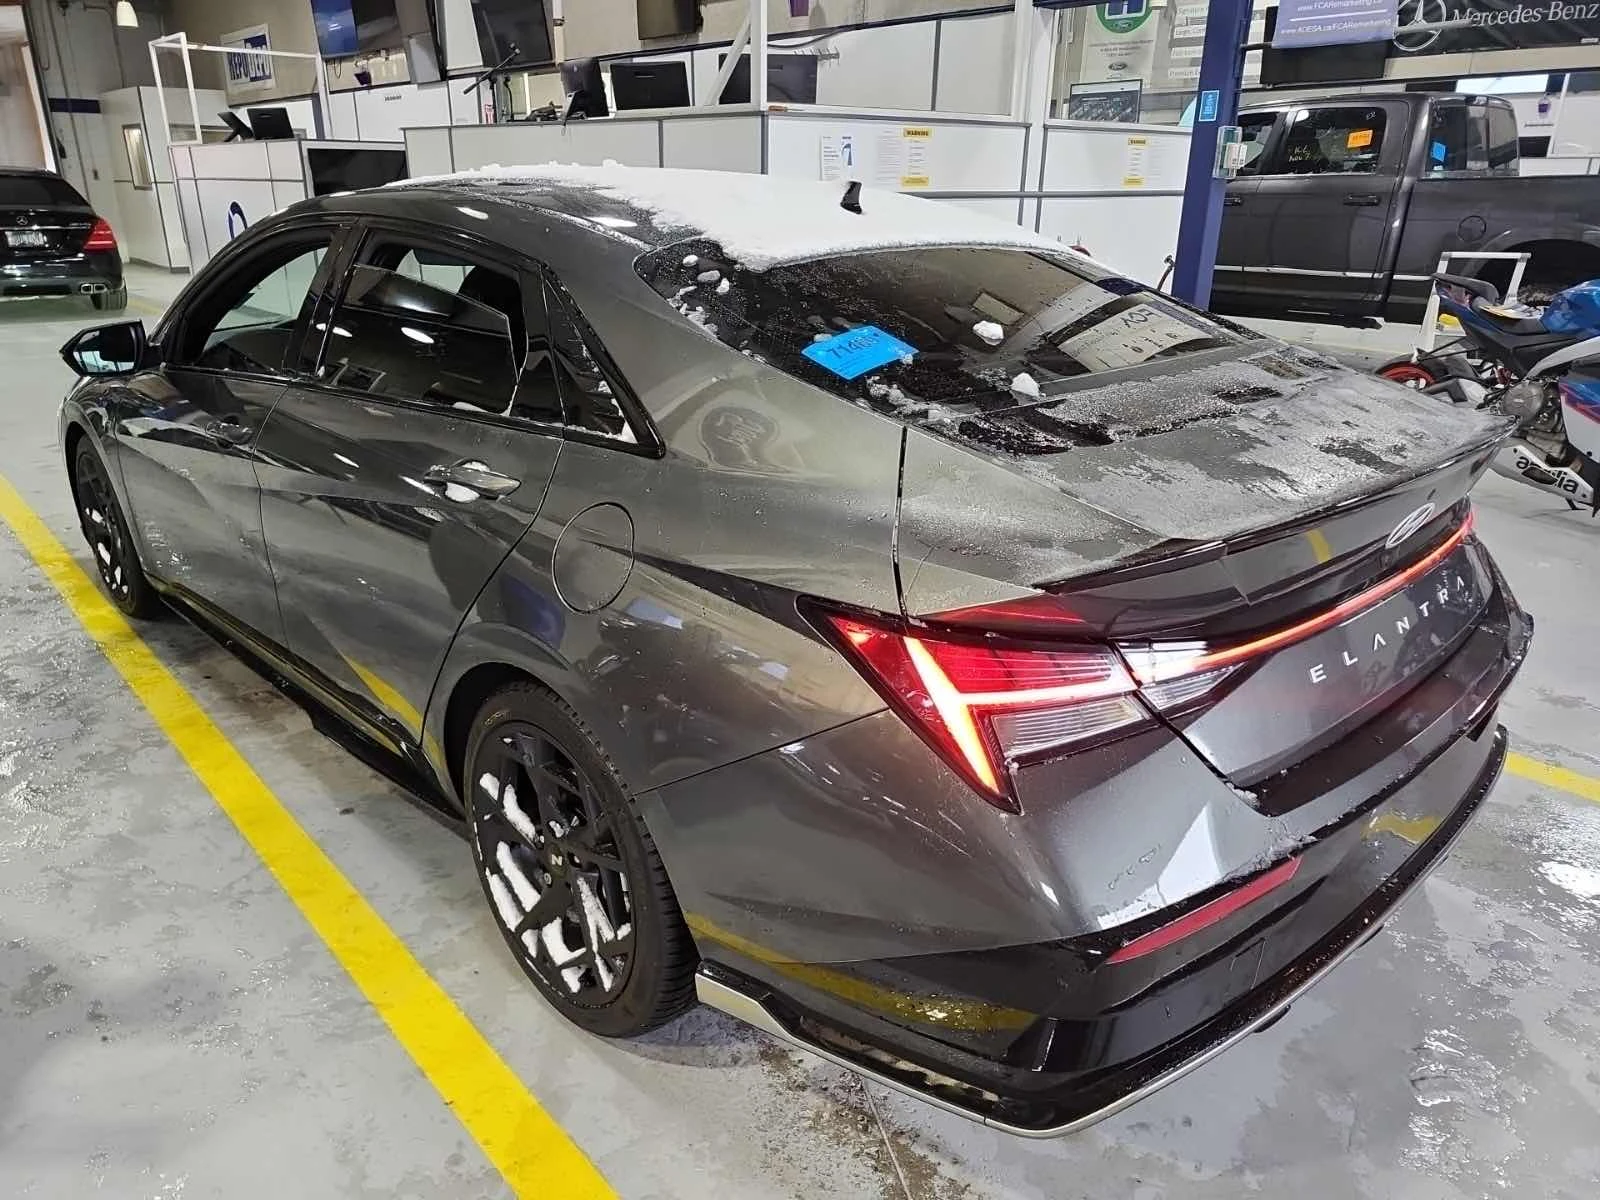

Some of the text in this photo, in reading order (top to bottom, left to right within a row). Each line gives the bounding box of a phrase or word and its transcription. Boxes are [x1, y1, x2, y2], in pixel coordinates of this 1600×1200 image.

[1452, 1, 1599, 26] Mercedes-Benz
[1309, 575, 1465, 684] ELANTRA
[551, 854, 563, 866] N
